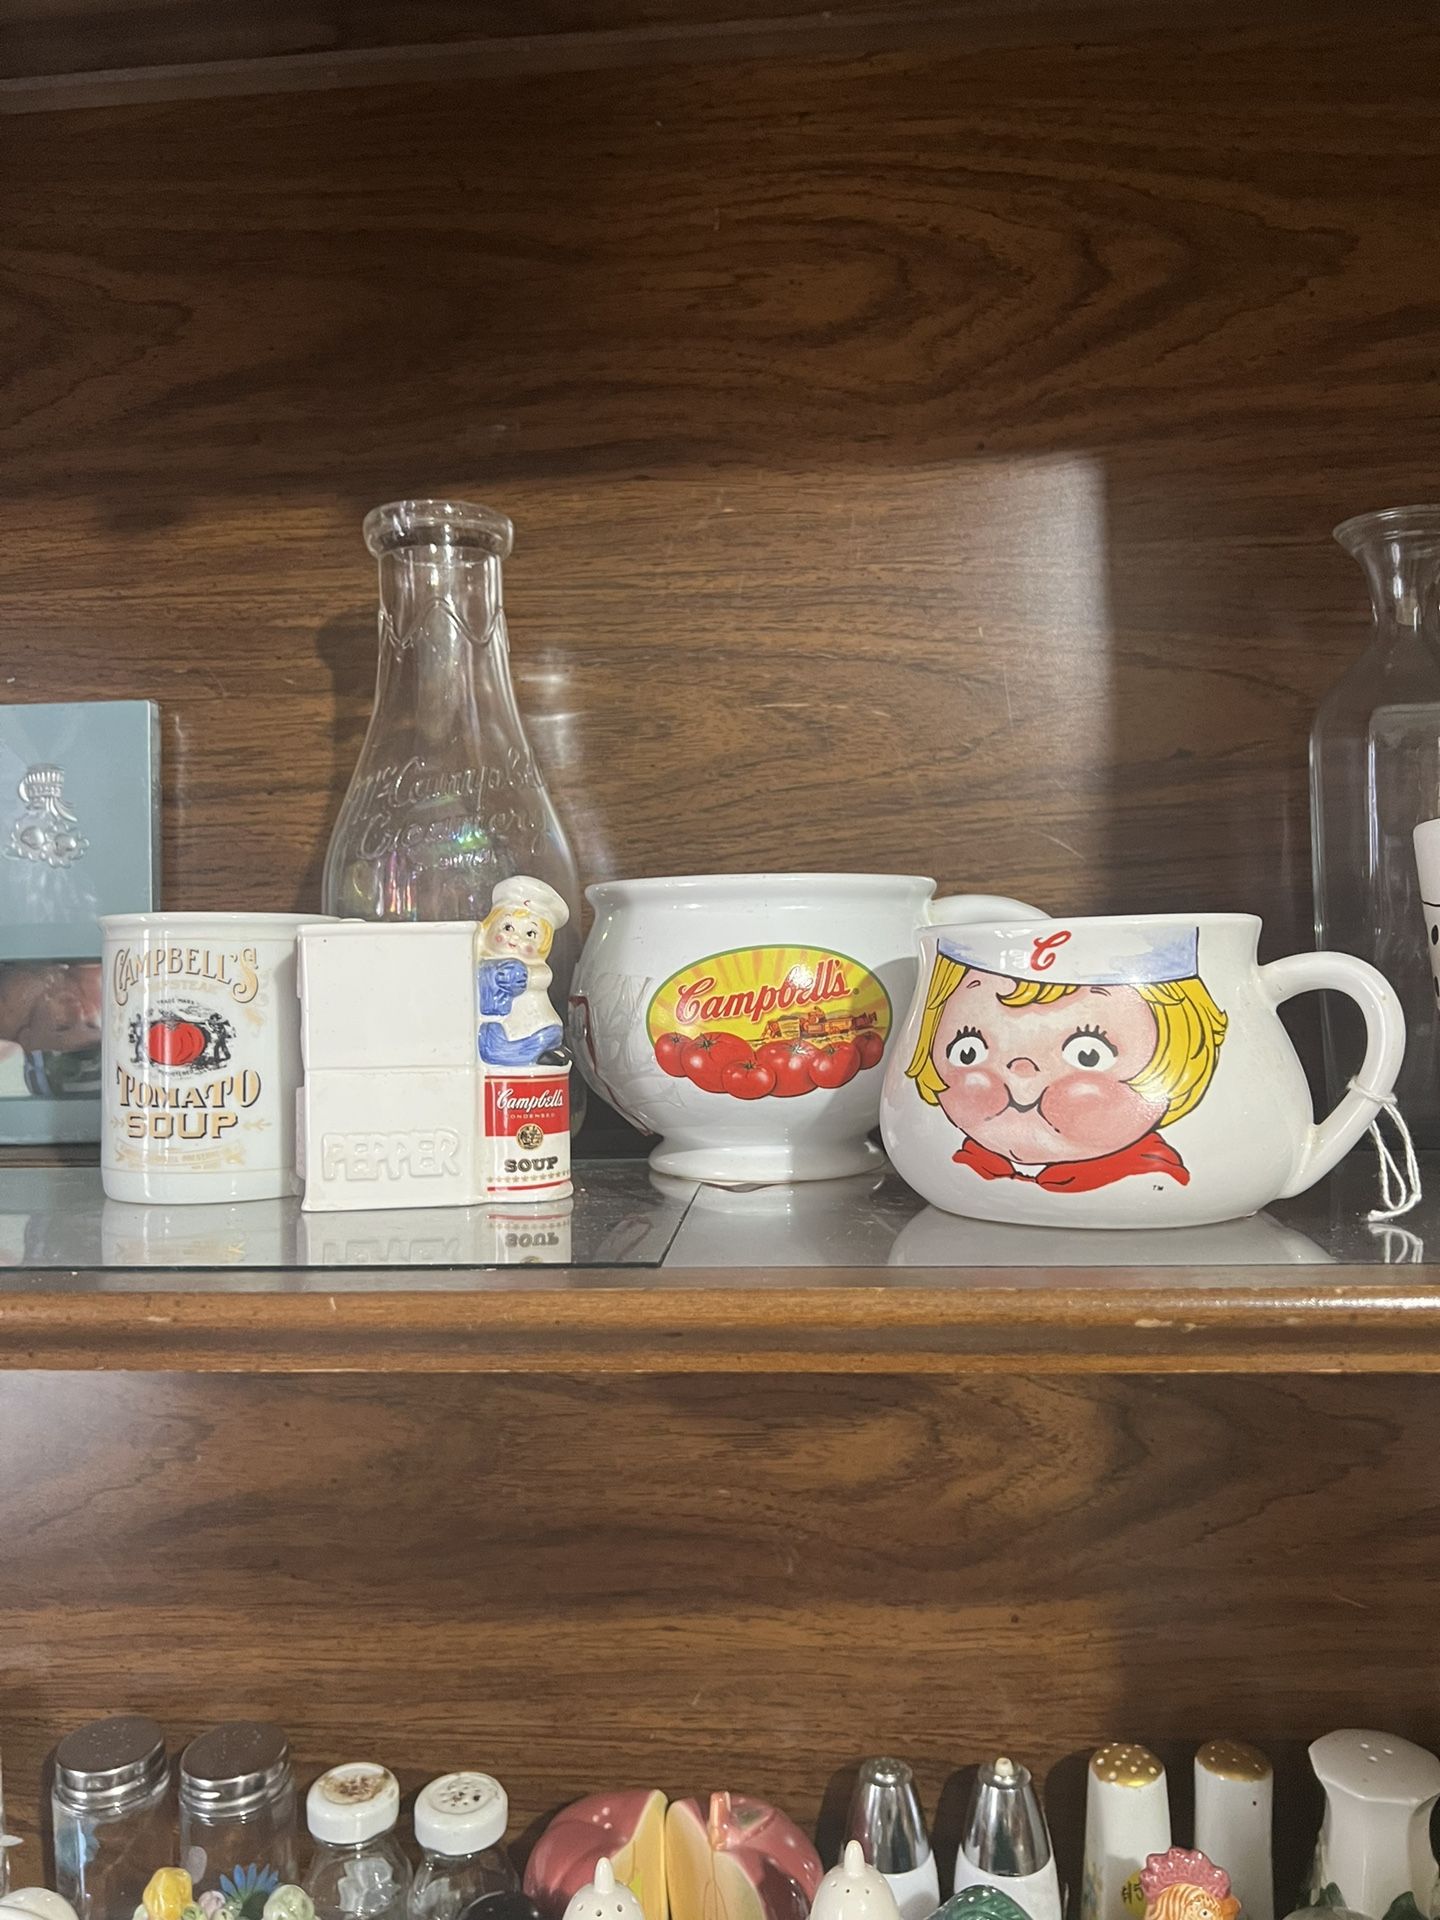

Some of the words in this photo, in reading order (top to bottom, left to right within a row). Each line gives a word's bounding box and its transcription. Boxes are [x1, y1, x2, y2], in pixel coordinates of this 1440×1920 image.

[1030, 931, 1072, 971] C
[113, 947, 259, 1006] CAMPBELL'S
[675, 959, 852, 1023] Campbell's
[116, 1066, 262, 1108] TOMATO
[126, 1112, 238, 1139] SOUP
[502, 1112, 556, 1120] ONDENSED
[321, 1129, 460, 1181] PEPPER
[504, 1156, 558, 1173] SOUP
